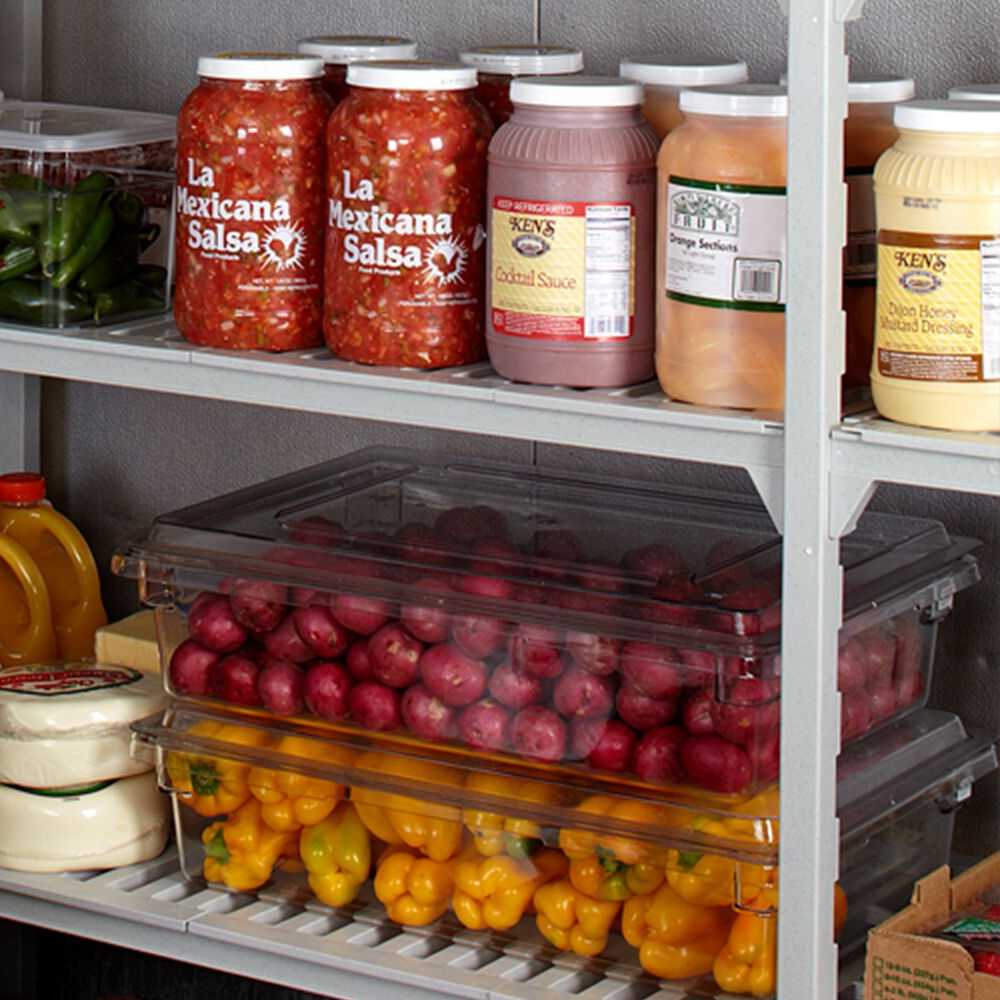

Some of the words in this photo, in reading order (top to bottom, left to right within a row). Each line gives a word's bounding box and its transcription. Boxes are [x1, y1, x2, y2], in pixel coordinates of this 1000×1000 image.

[187, 157, 215, 188] La
[343, 169, 375, 201] La
[177, 185, 291, 222] Mexicana
[329, 198, 454, 235] Mexicana
[188, 219, 261, 253] Salsa
[508, 217, 557, 239] KEN'S
[343, 233, 423, 268] Salsa
[698, 238, 739, 254] Sections
[894, 250, 948, 272] KEN'S
[494, 265, 535, 289] Cocktail
[537, 271, 577, 290] Sauce
